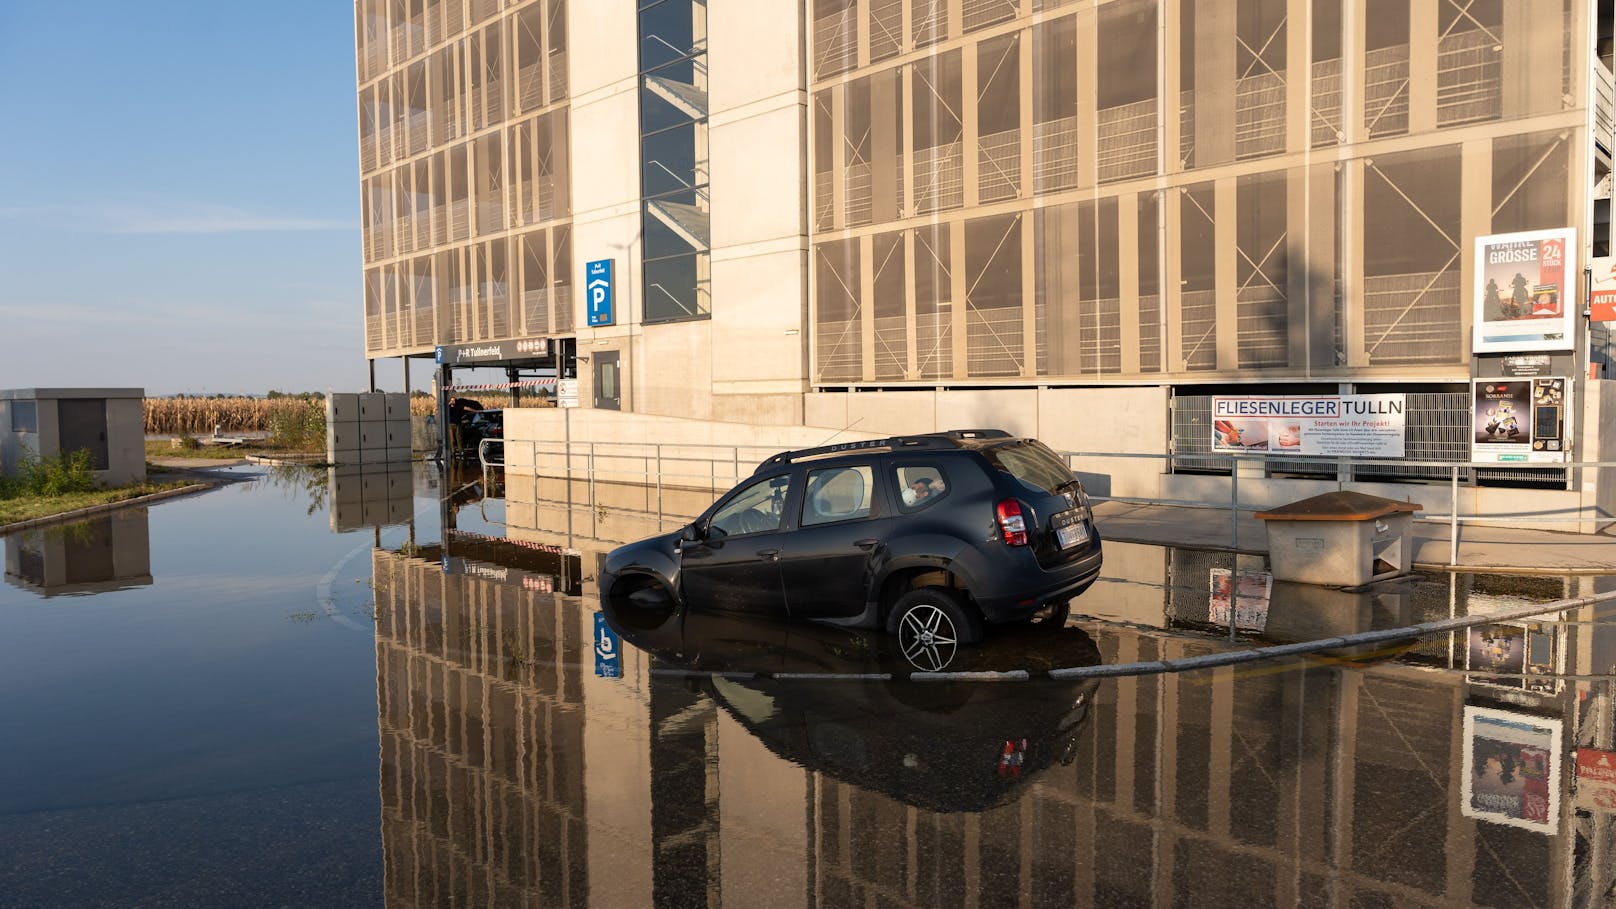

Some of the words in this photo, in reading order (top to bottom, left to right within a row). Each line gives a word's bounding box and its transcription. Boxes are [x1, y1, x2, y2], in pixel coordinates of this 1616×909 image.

[1489, 248, 1537, 264] GRÖSSE
[1542, 245, 1562, 260] 24
[1542, 259, 1562, 267] STÜCK
[593, 287, 605, 312] P
[458, 349, 470, 358] P+R
[471, 345, 500, 357] Tullnerfeld
[1217, 401, 1336, 415] FLIESENLEGER
[1343, 400, 1402, 414] TULLN
[1362, 420, 1390, 429] Projekt!
[831, 440, 886, 451] DUSTER
